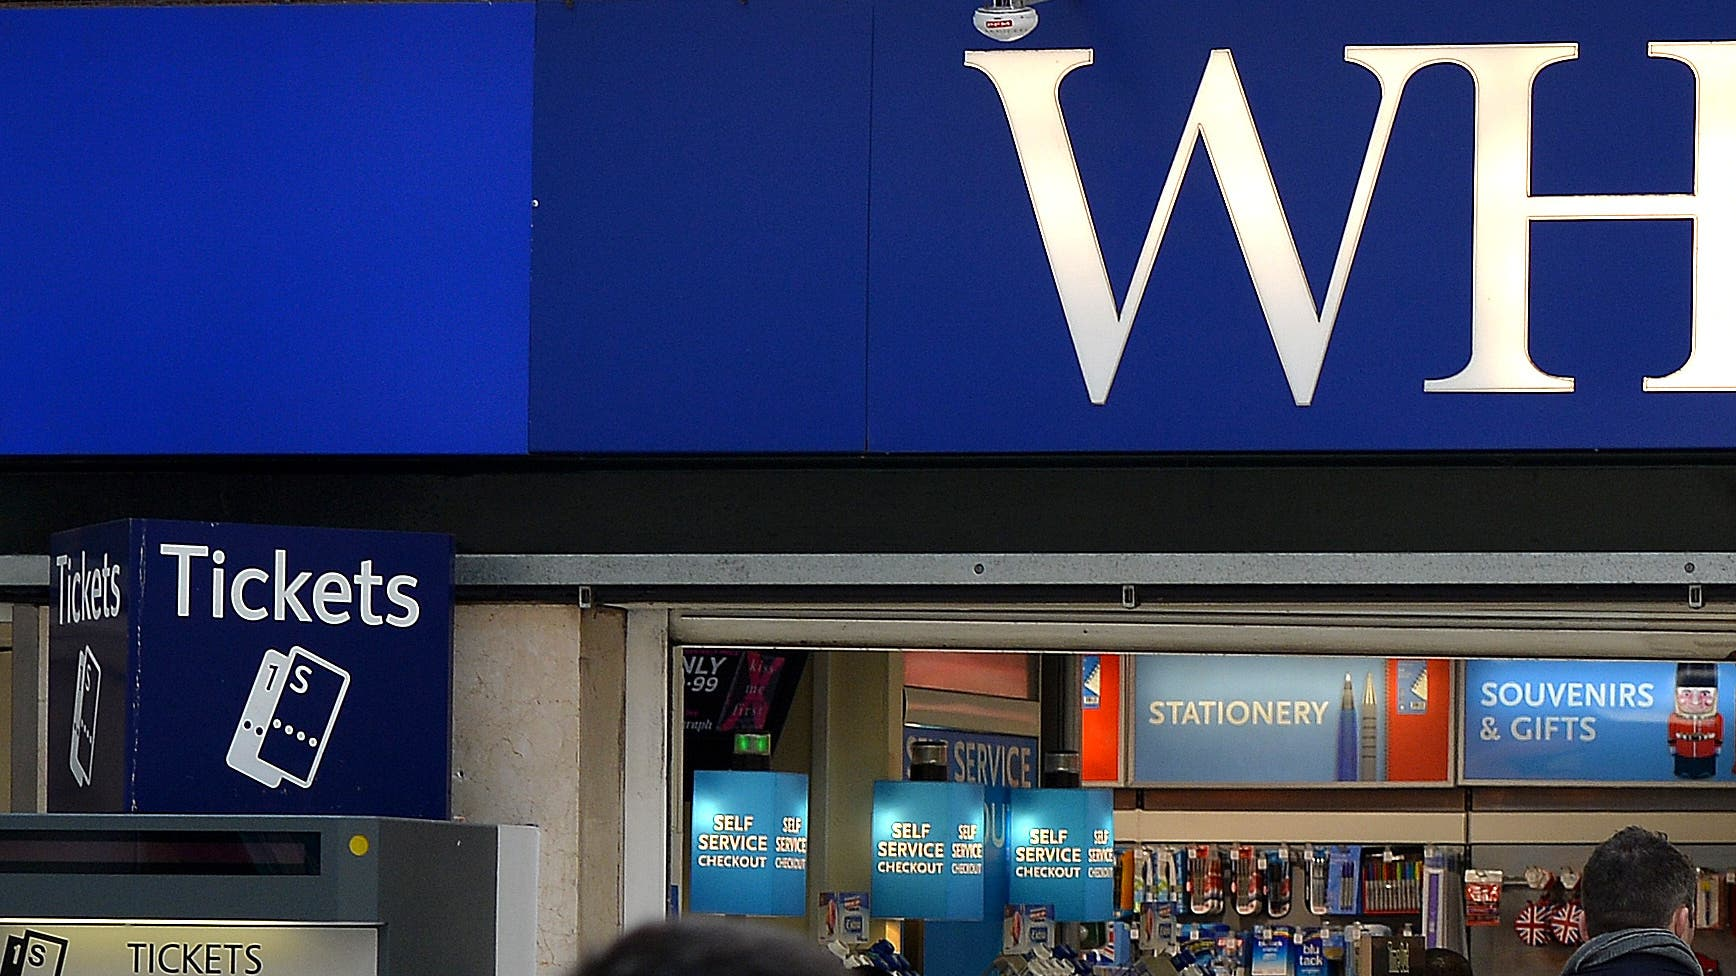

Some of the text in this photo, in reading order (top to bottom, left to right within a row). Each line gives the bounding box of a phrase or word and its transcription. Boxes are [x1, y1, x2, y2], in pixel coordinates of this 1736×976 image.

[56, 551, 121, 625] Tickets
[160, 543, 420, 628] Tickets
[1480, 682, 1655, 708] SOUVENIRS
[1149, 700, 1329, 726] STATIONERY
[1479, 716, 1597, 742] & GIFTS
[954, 740, 1031, 788] SERVICE
[714, 814, 753, 831] SELF
[891, 822, 930, 839] SELF
[698, 834, 768, 851] SERVICE
[1029, 829, 1068, 845] SELF
[877, 842, 944, 858] SERVICE
[1015, 847, 1081, 863] SERVICE
[698, 855, 768, 868] CHECKOUT
[877, 861, 944, 874] CHECKOUT
[1015, 866, 1081, 879] CHECKOUT
[127, 943, 263, 976] TICKETS
